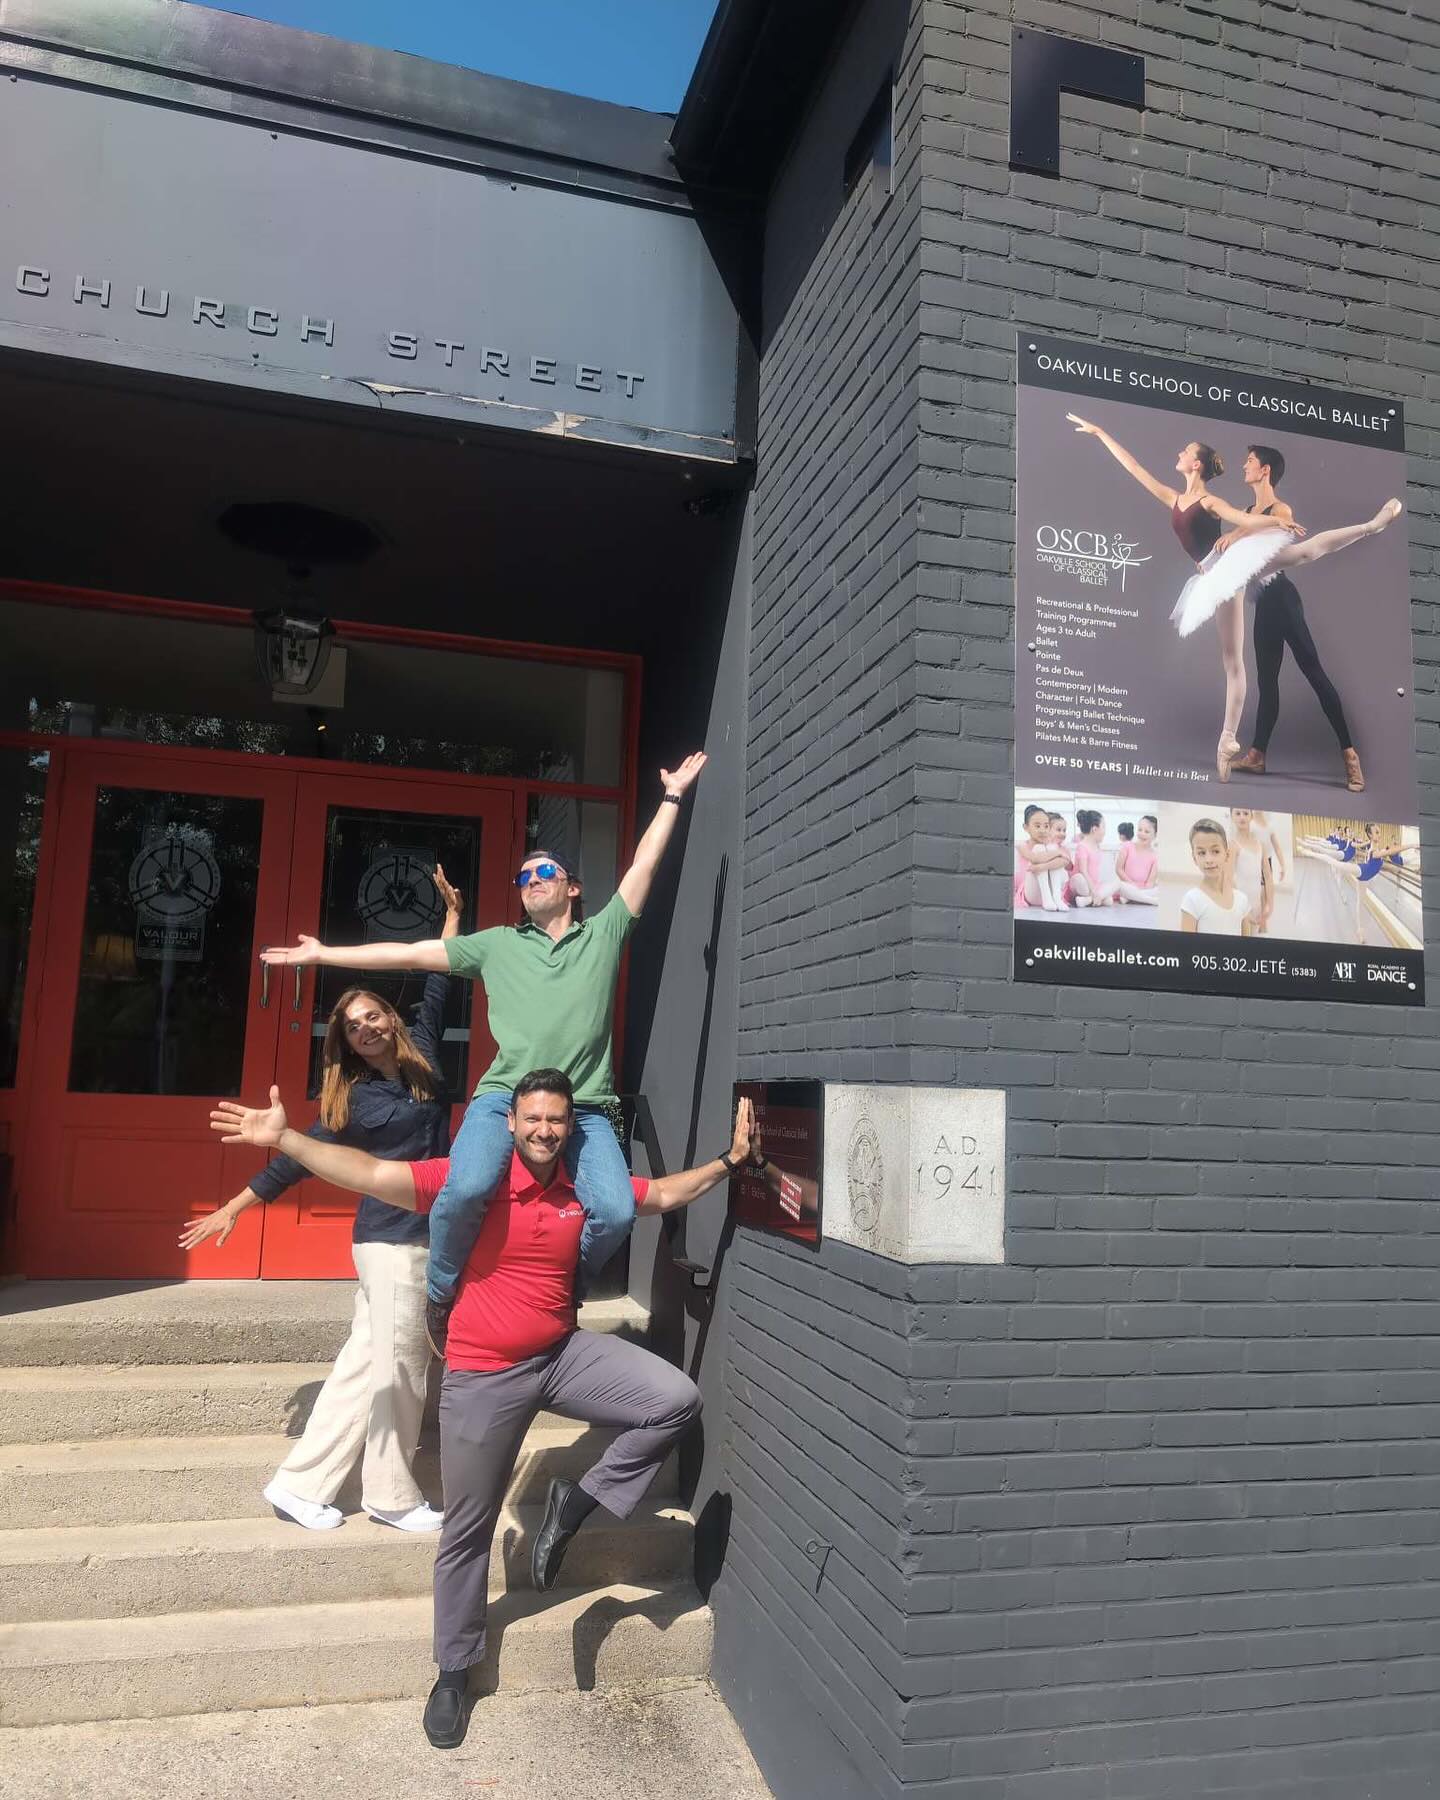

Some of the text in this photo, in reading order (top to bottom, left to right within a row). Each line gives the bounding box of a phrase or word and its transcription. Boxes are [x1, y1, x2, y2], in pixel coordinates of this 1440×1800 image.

[15, 265, 645, 399] CHURCH STREET
[1037, 354, 1390, 432] OAKVILLE SCHOOL OF CLASSICAL BALLET
[1036, 525, 1108, 557] OSCB
[1036, 553, 1106, 571] OAKVILLE SCHOOL
[1053, 563, 1108, 579] OF CLASSICAL
[1080, 575, 1108, 587] BALLET
[1036, 596, 1139, 618] Recreational & Professional
[1036, 609, 1117, 628] Training Programmes
[1036, 623, 1096, 639] Ages 3 to Adult
[1036, 636, 1058, 648] Ballet
[1036, 650, 1061, 661] Pointe
[1035, 663, 1084, 677] Pas de Deux
[1035, 677, 1092, 693] Contemporary
[1097, 684, 1128, 696] Modern
[1035, 690, 1074, 702] Character
[1079, 695, 1096, 705] Folk
[1098, 697, 1123, 709] Dance
[1035, 704, 1145, 726] Progressing Ballet Technique
[1058, 720, 1065, 729] &
[1091, 724, 1120, 735] Classes
[1035, 731, 1138, 751] Pilates Mat & Barre Fitness
[1035, 754, 1067, 768] OVER
[1070, 758, 1084, 769] 50
[1087, 760, 1122, 773] YEARS
[1132, 764, 1162, 777] Ballet
[1164, 770, 1174, 778] at
[1176, 770, 1188, 780] its
[1191, 771, 1209, 782] Best
[1033, 944, 1318, 979] oakvilleballet.com 905.302.JETÉ (5383)
[1367, 969, 1407, 984] DANCE
[934, 1135, 981, 1156] A.D.
[917, 1163, 997, 1200] 1941
